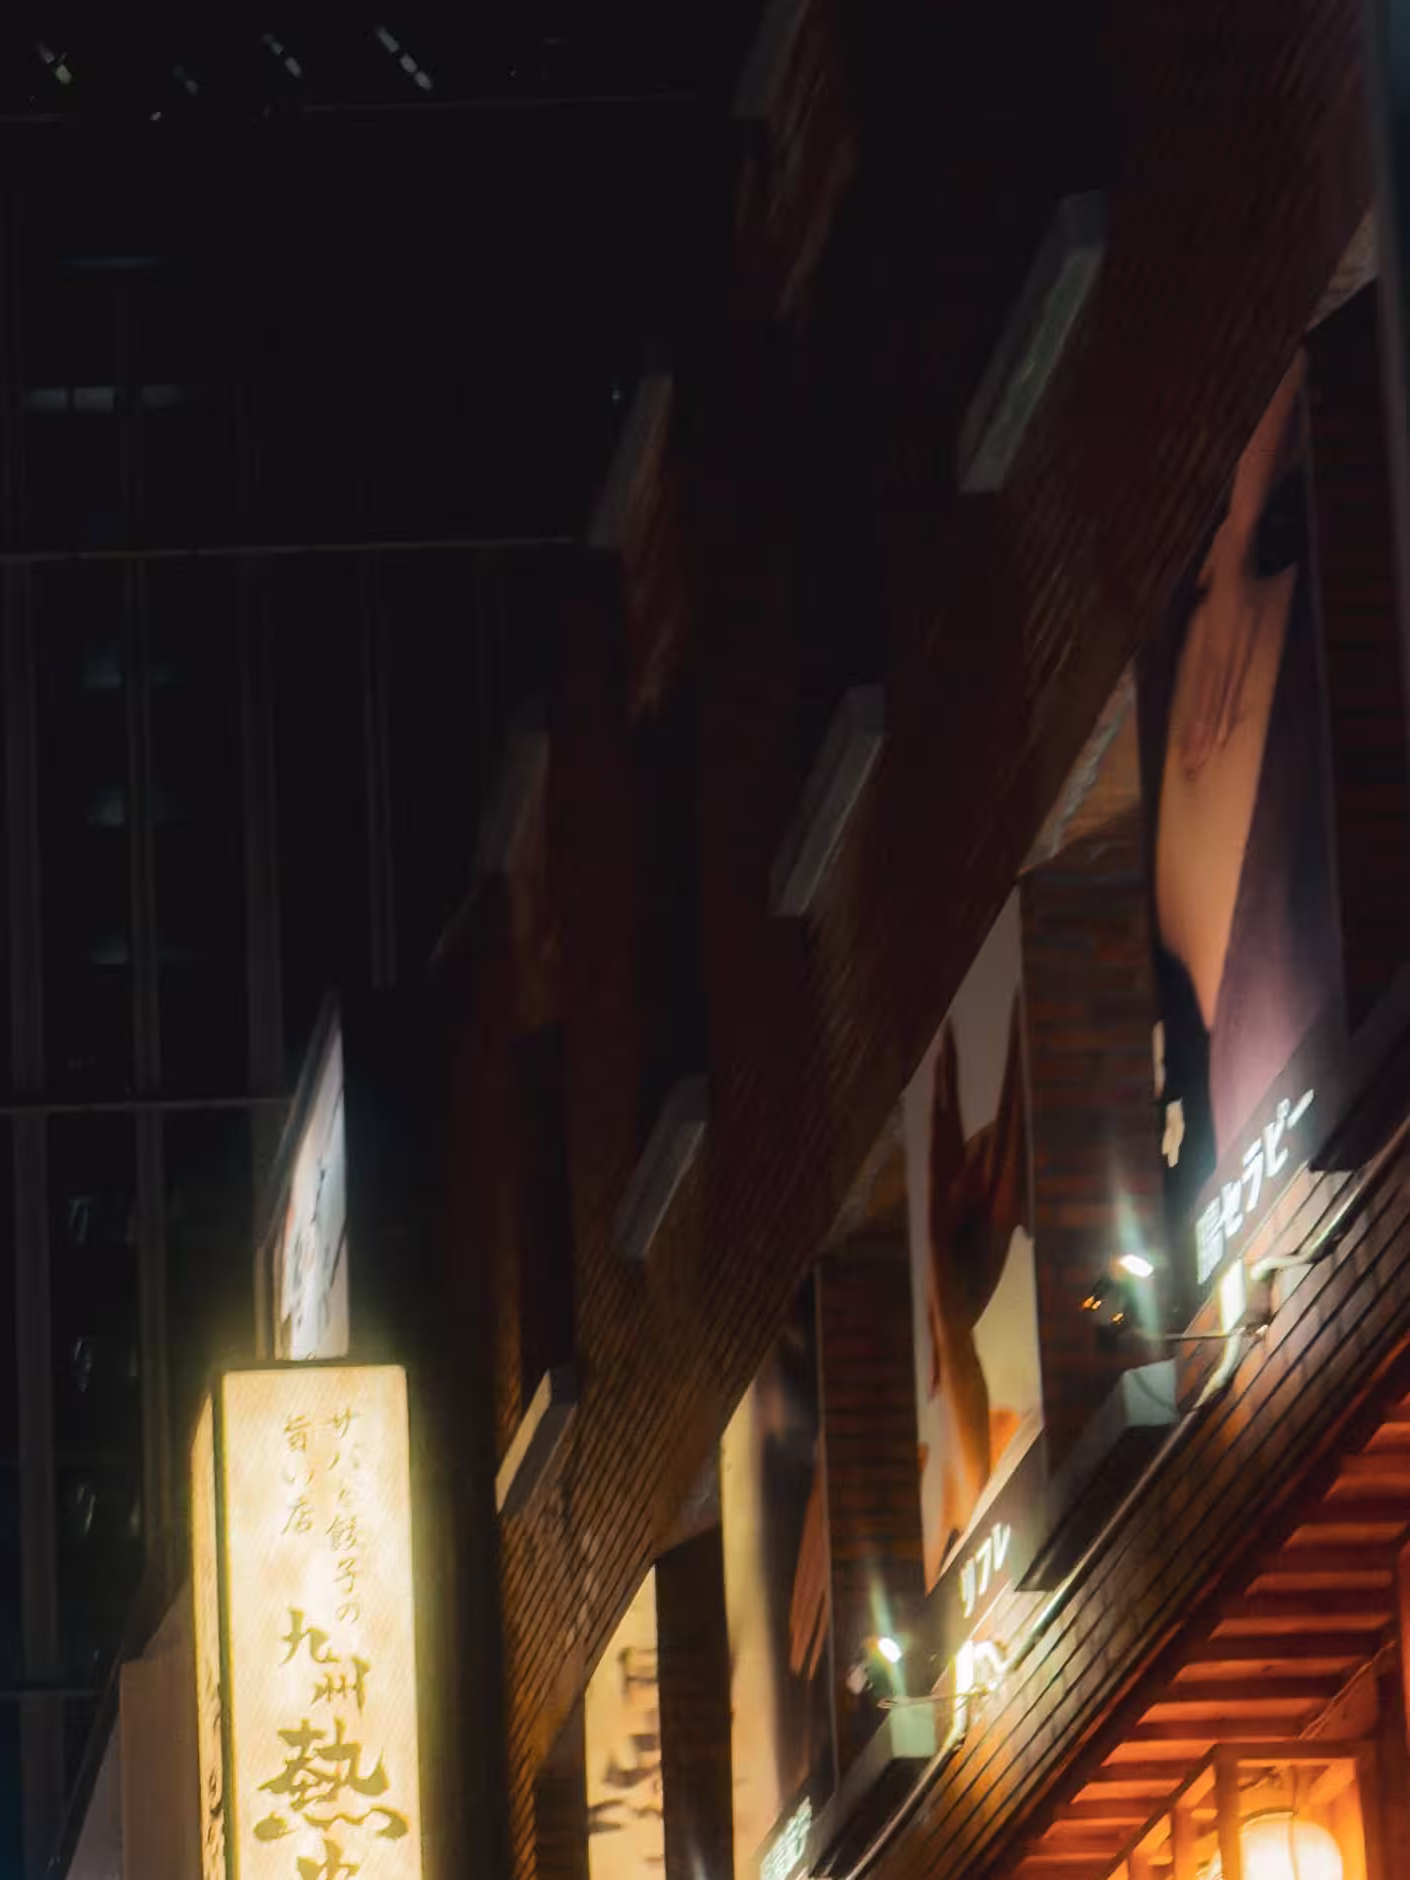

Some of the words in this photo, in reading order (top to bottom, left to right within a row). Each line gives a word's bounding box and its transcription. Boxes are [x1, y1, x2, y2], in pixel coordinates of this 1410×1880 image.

[281, 1411, 315, 1537] 旨い店
[323, 1406, 361, 1624] サバと餃子の
[958, 1522, 1012, 1611] リフレ
[280, 1608, 370, 1708] 九州
